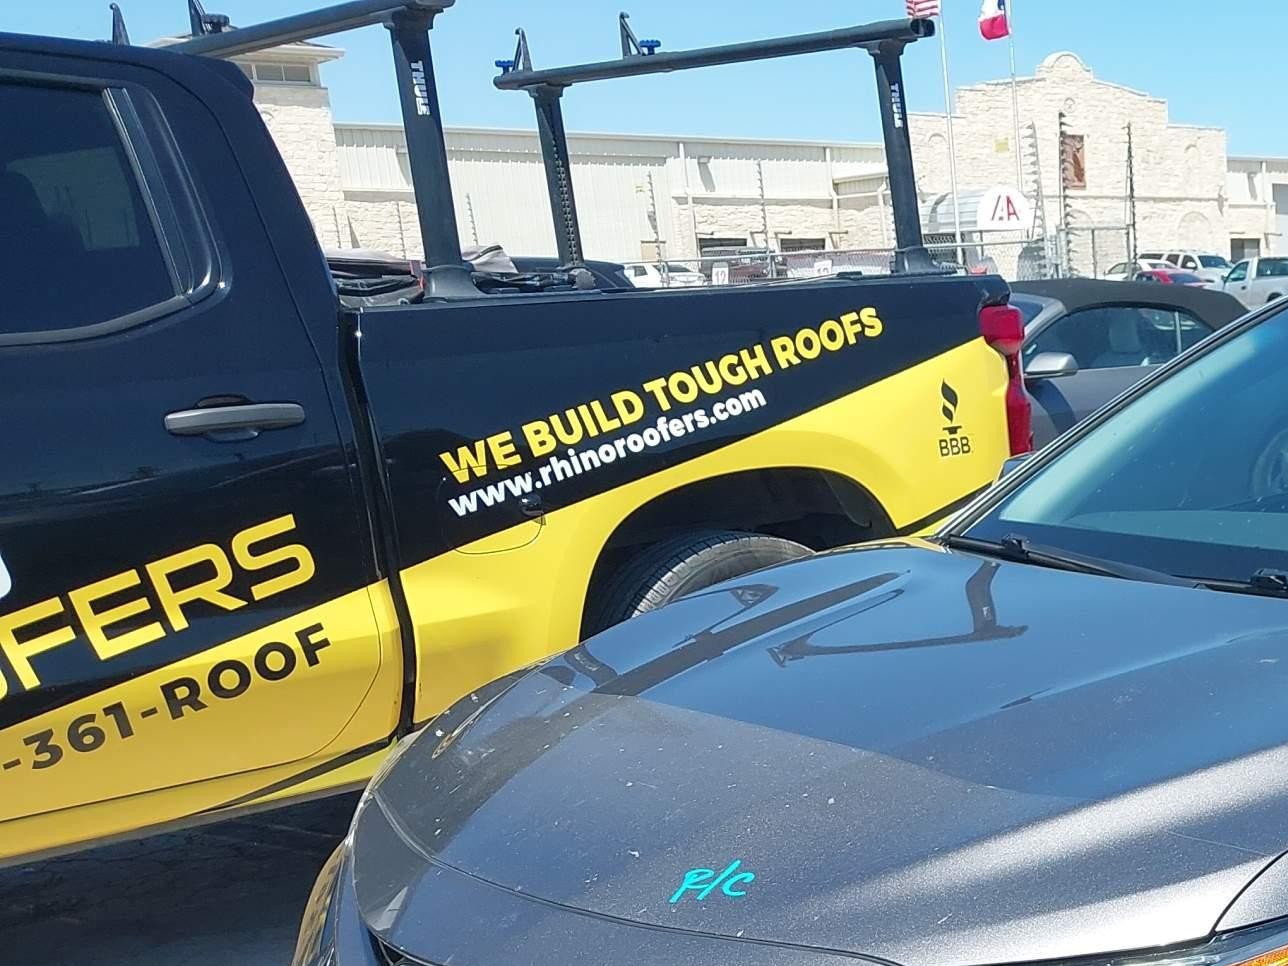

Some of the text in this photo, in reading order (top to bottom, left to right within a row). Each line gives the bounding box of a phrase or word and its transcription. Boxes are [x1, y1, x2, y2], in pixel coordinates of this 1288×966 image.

[410, 60, 431, 116] THULE
[438, 306, 884, 484] WE BUILD TOUGH ROOFS
[447, 388, 768, 517] www.rhinoroofers.com
[938, 436, 971, 457] BBB
[0, 513, 316, 699] FERS
